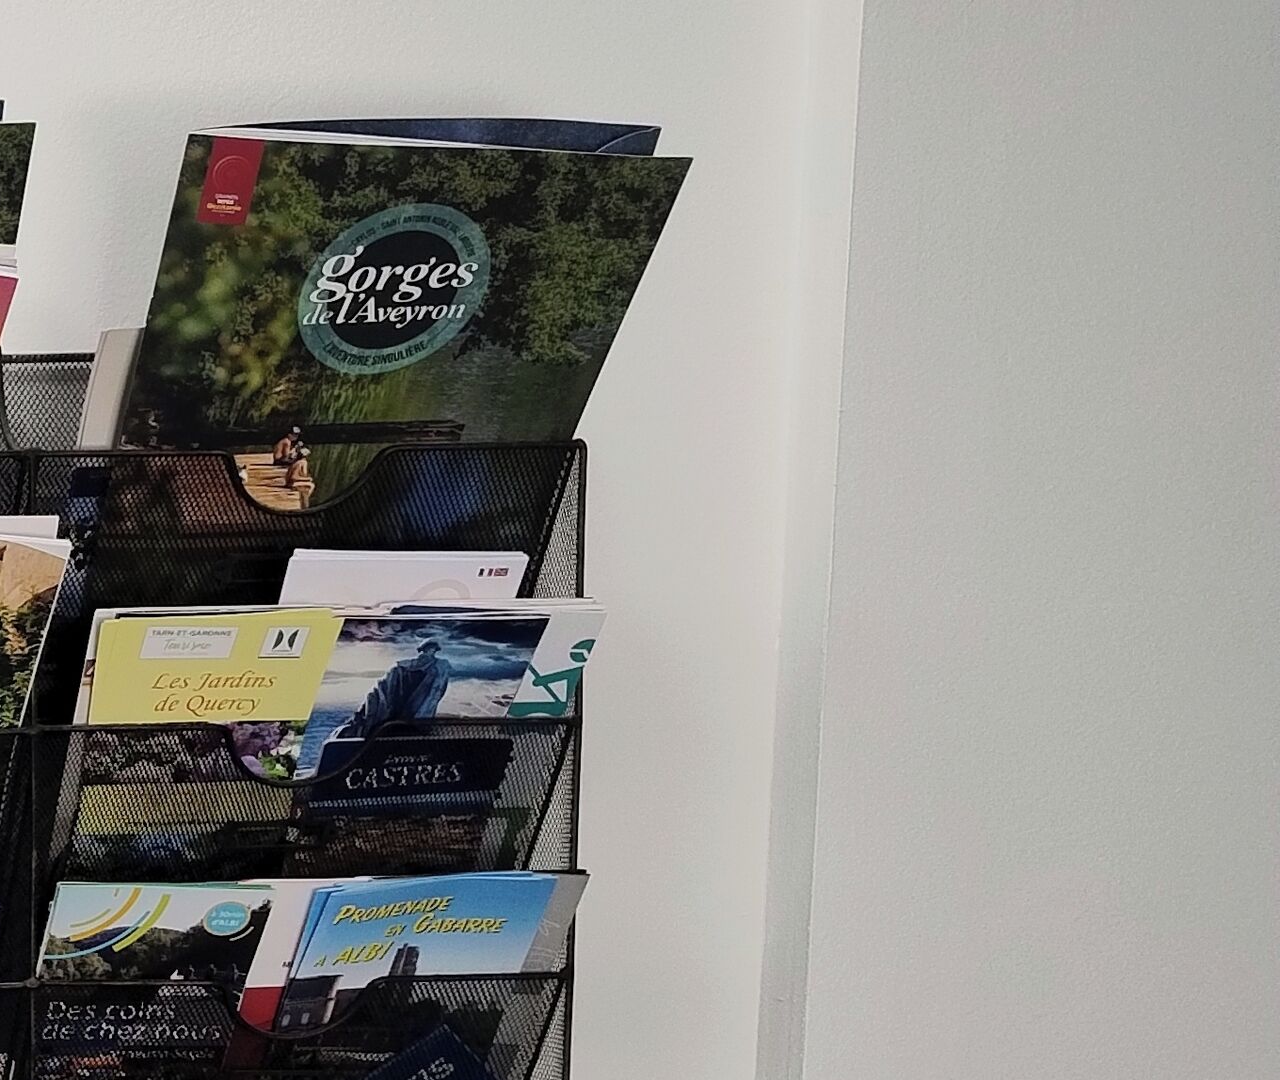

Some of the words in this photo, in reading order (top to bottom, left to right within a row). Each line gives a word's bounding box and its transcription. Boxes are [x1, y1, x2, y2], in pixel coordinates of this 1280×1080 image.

[309, 245, 479, 303] gorges
[302, 303, 334, 325] de
[335, 293, 466, 329] l'Aveyron
[152, 672, 191, 690] Les
[193, 670, 277, 691] Jardins
[154, 693, 180, 712] de
[186, 694, 261, 717] Quercy
[345, 764, 462, 789] CASTRES
[333, 896, 454, 925] PROMENADE
[384, 924, 405, 938] EN
[412, 913, 508, 935] GABARRE
[332, 940, 393, 966] ALBI
[47, 1001, 97, 1020] Des
[106, 1001, 176, 1020] coins
[42, 1023, 75, 1040] de
[84, 1022, 146, 1040] chez
[155, 1023, 222, 1041] nous
